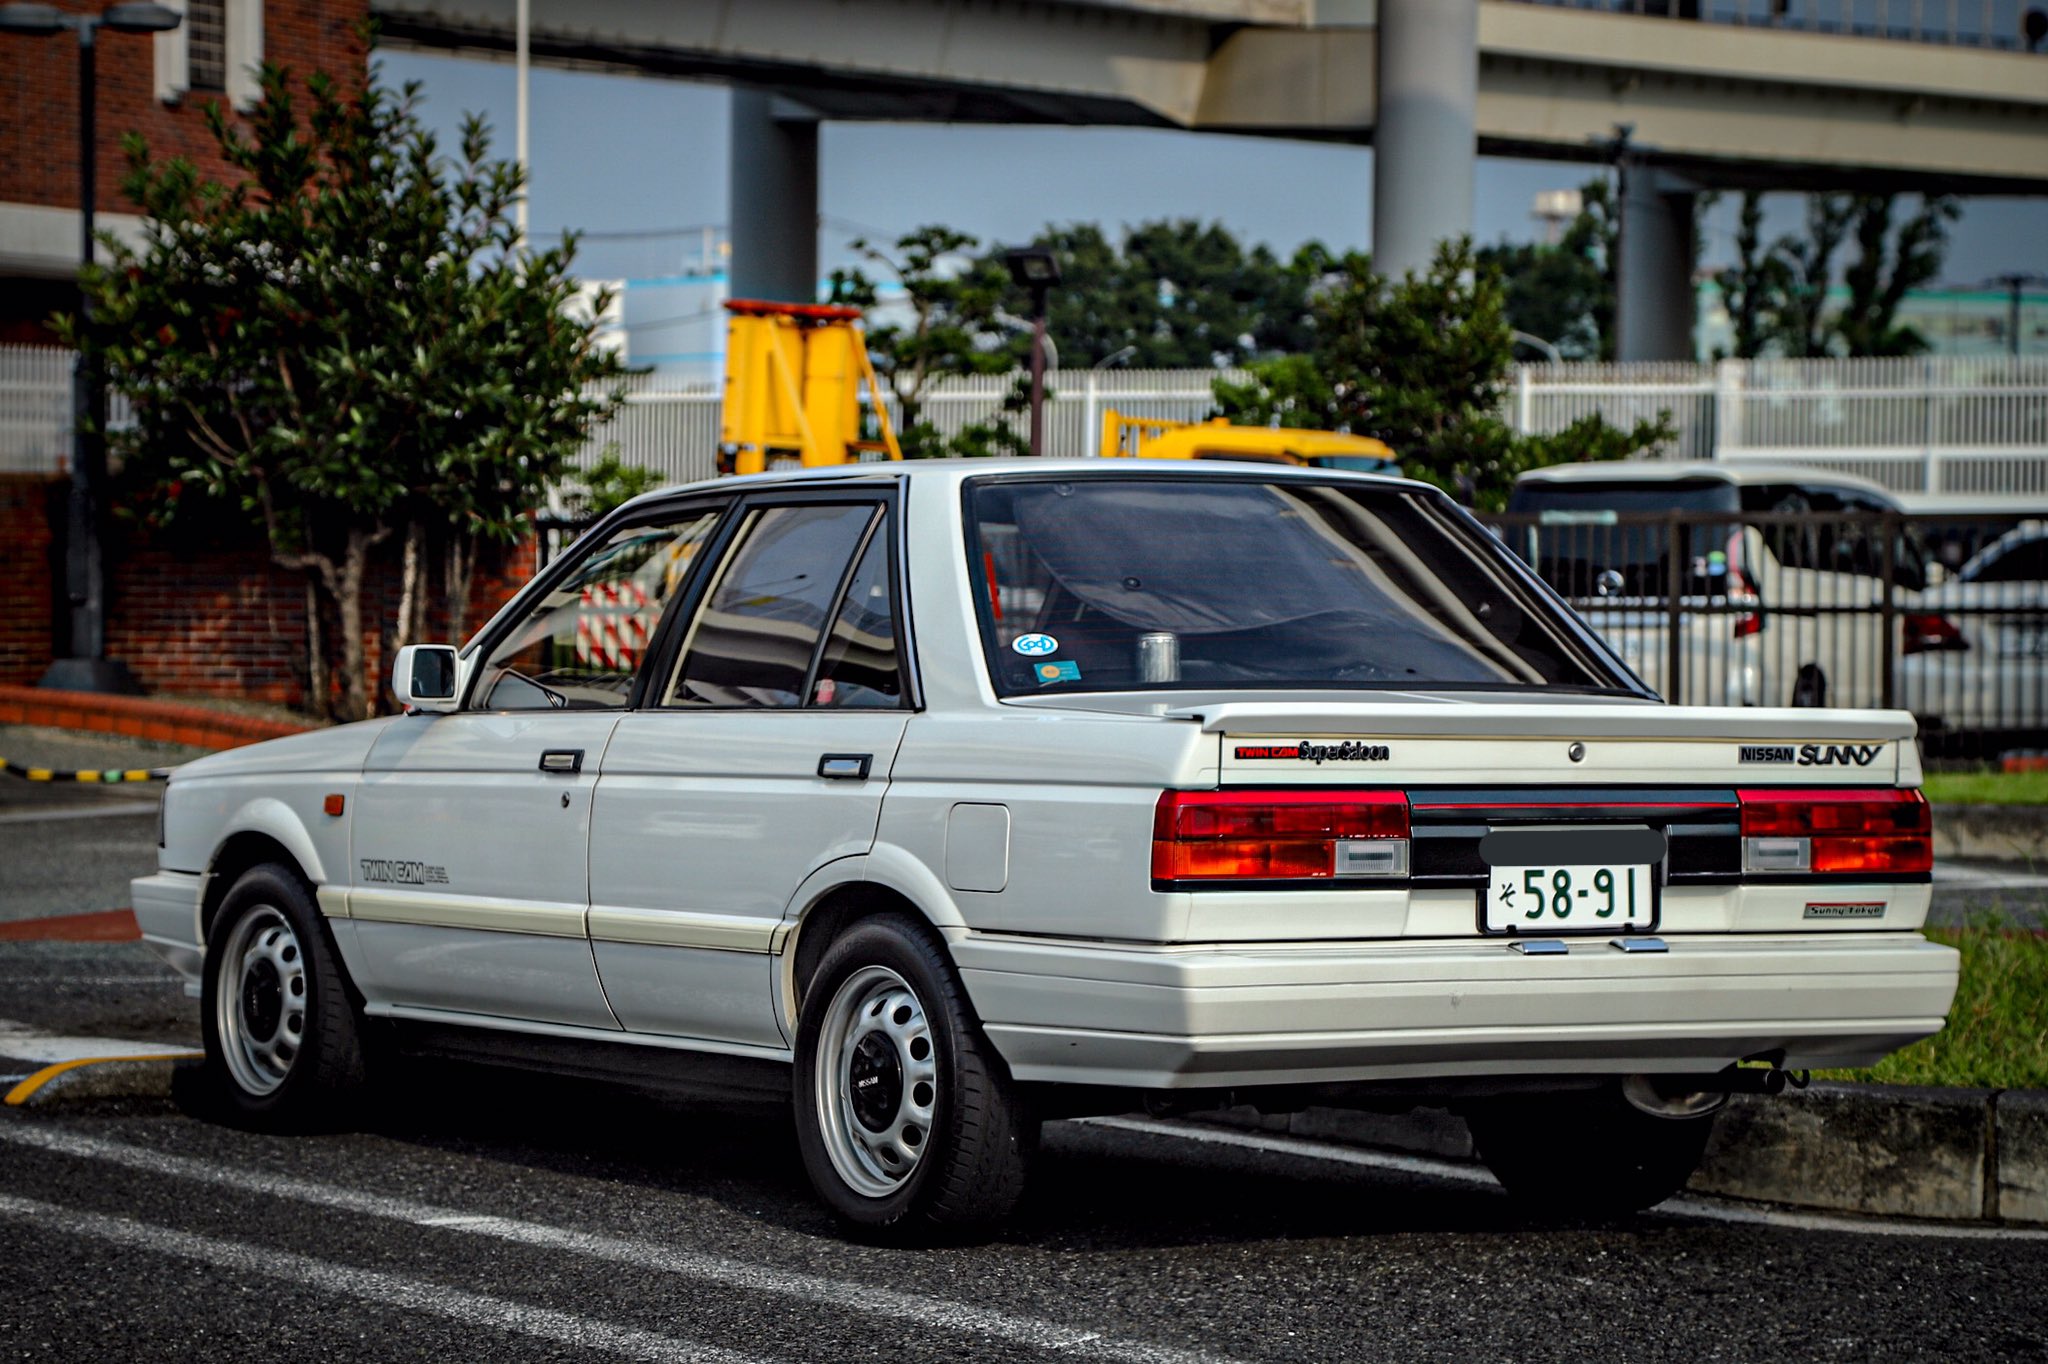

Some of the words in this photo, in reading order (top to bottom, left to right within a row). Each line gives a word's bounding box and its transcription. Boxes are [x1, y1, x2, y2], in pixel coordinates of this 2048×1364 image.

[1237, 747, 1269, 757] TWIN
[1271, 747, 1299, 757] CAM
[1741, 747, 1795, 761] NISSAN
[1797, 744, 1882, 766] SUNNY
[361, 859, 394, 883] TWIN
[395, 861, 424, 885] CAM
[1499, 883, 1516, 908] そ
[1524, 868, 1635, 919] 58-91
[1811, 906, 1845, 917] Sunny
